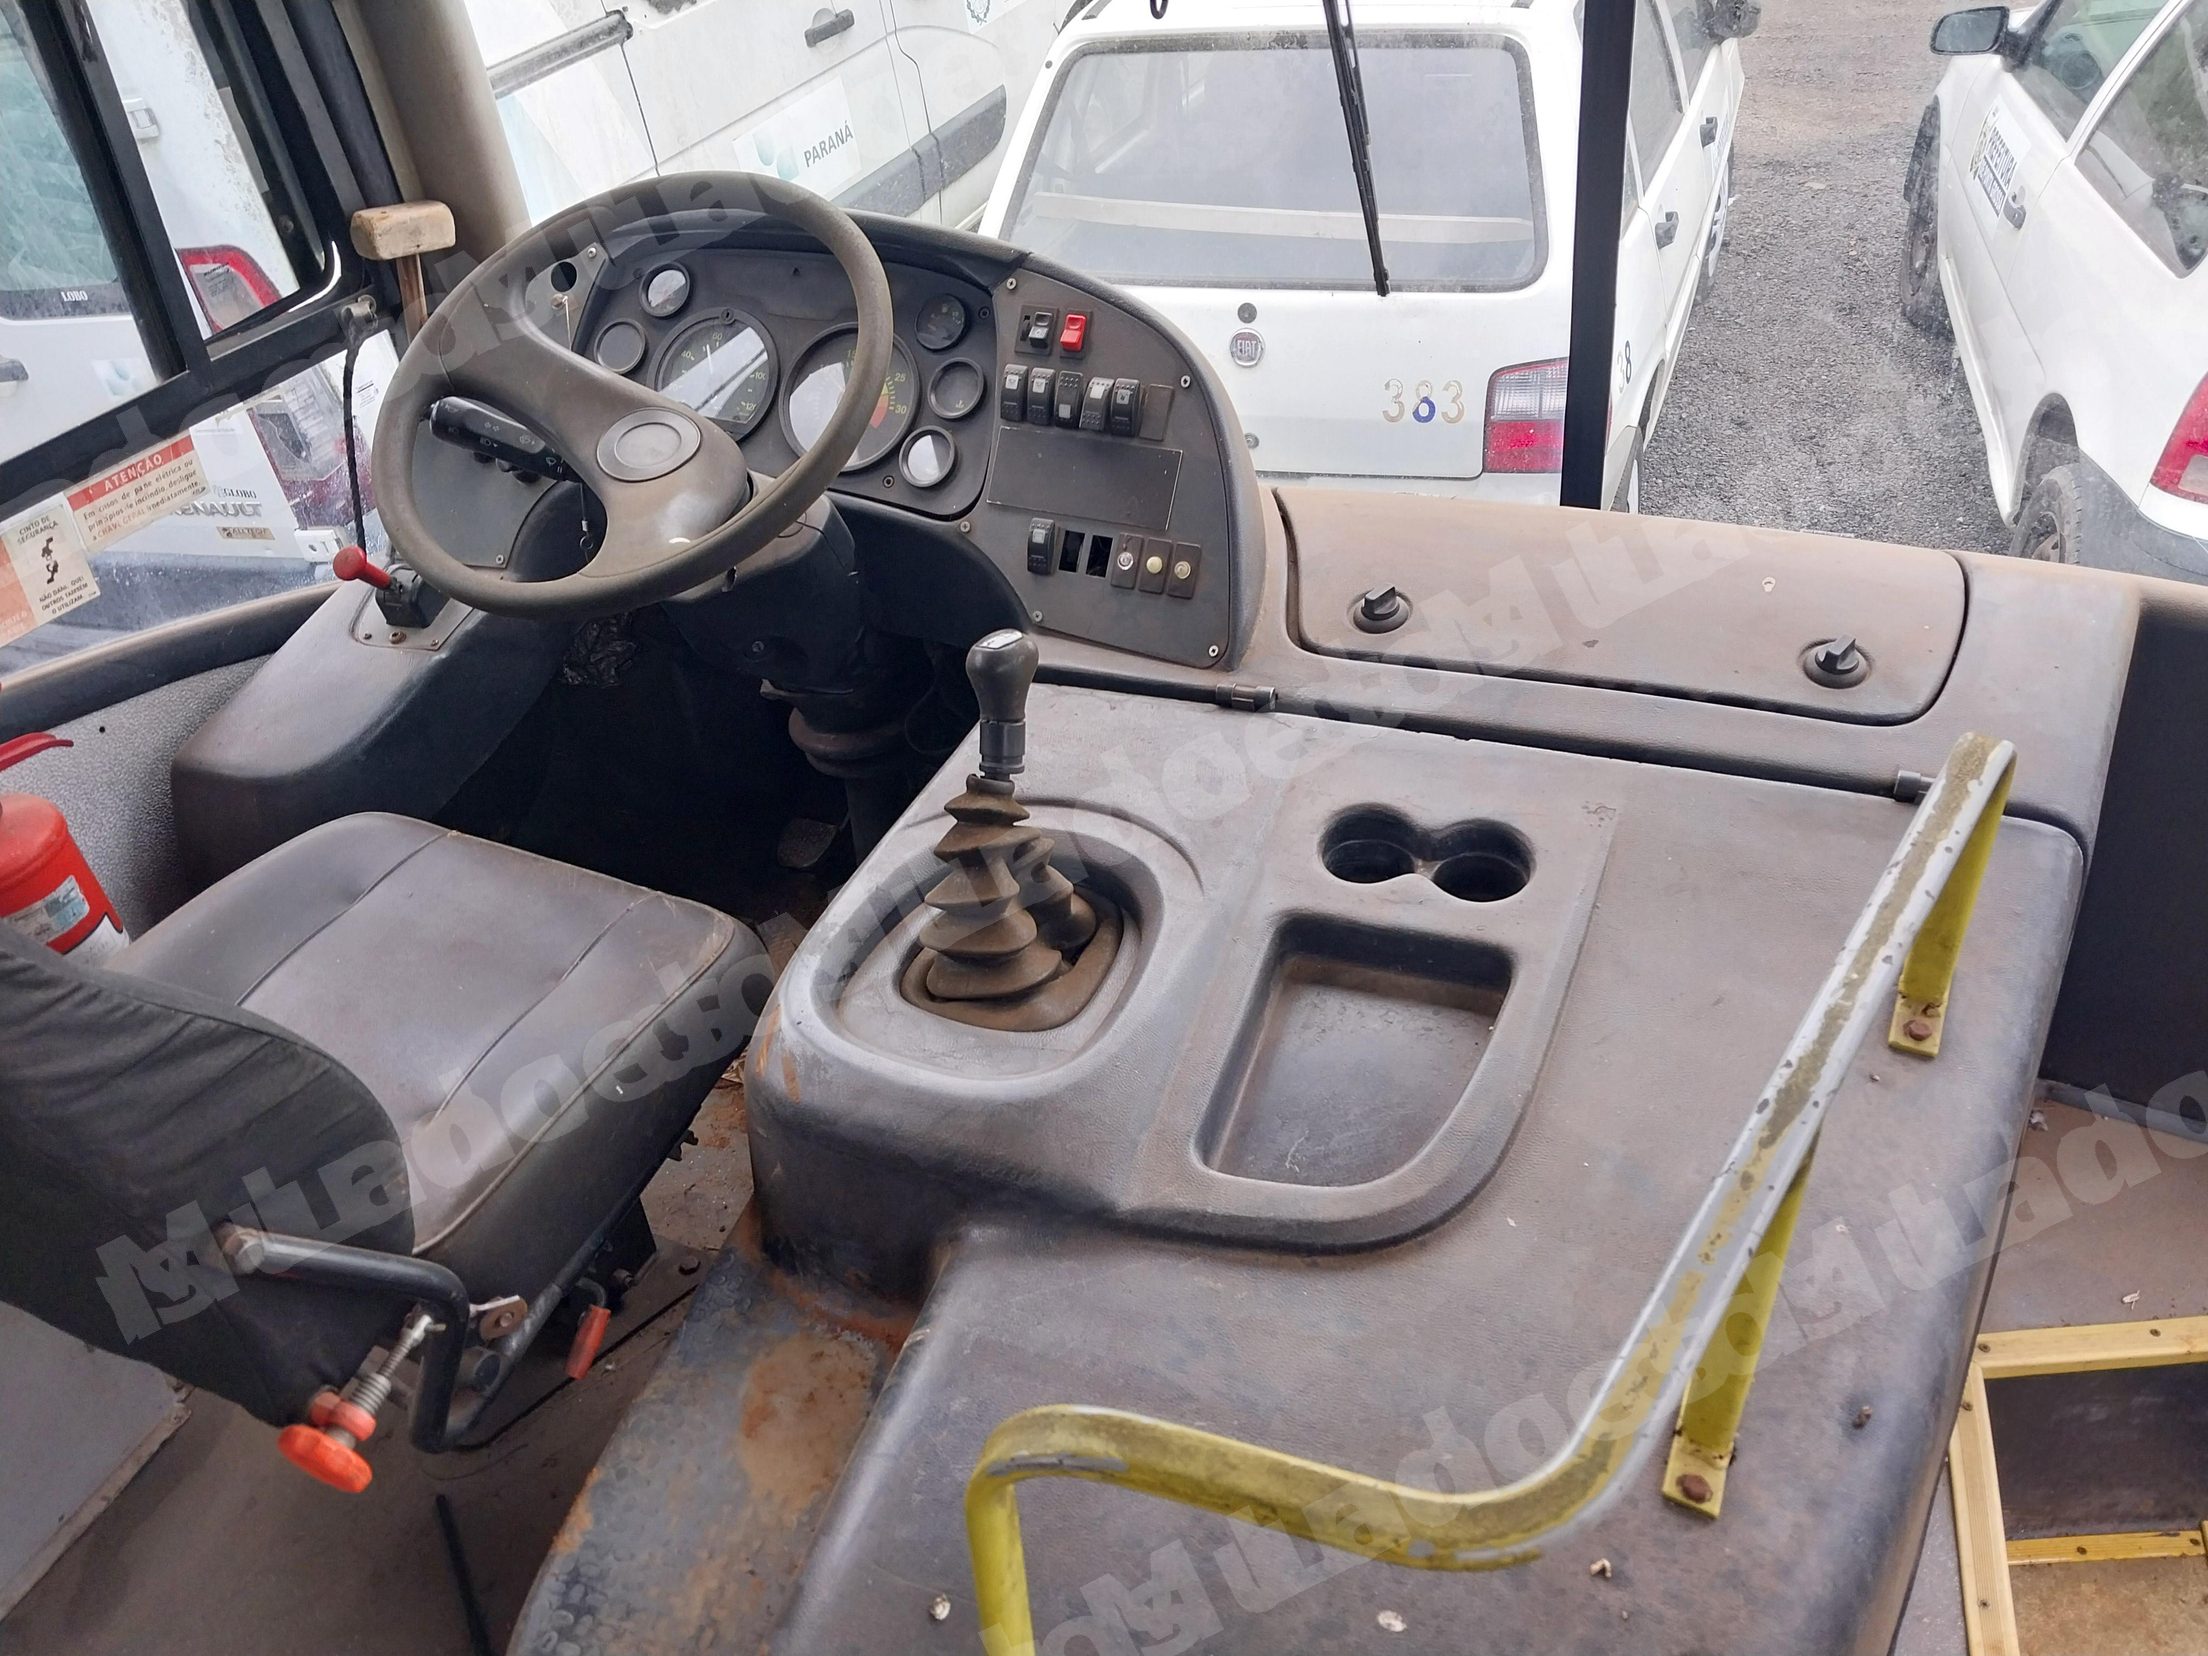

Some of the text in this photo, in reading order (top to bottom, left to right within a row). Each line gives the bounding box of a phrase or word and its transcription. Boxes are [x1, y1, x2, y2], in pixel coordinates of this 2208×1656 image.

[803, 120, 853, 168] PARANÁ
[1237, 339, 1257, 357] FIAT
[894, 372, 906, 382] 25
[895, 404, 907, 414] 30
[1382, 378, 1464, 424] 383
[83, 511, 96, 520] Em
[121, 490, 131, 500] de
[134, 481, 153, 495] pane
[172, 501, 262, 517] ENAULT
[19, 519, 40, 535] CINTO
